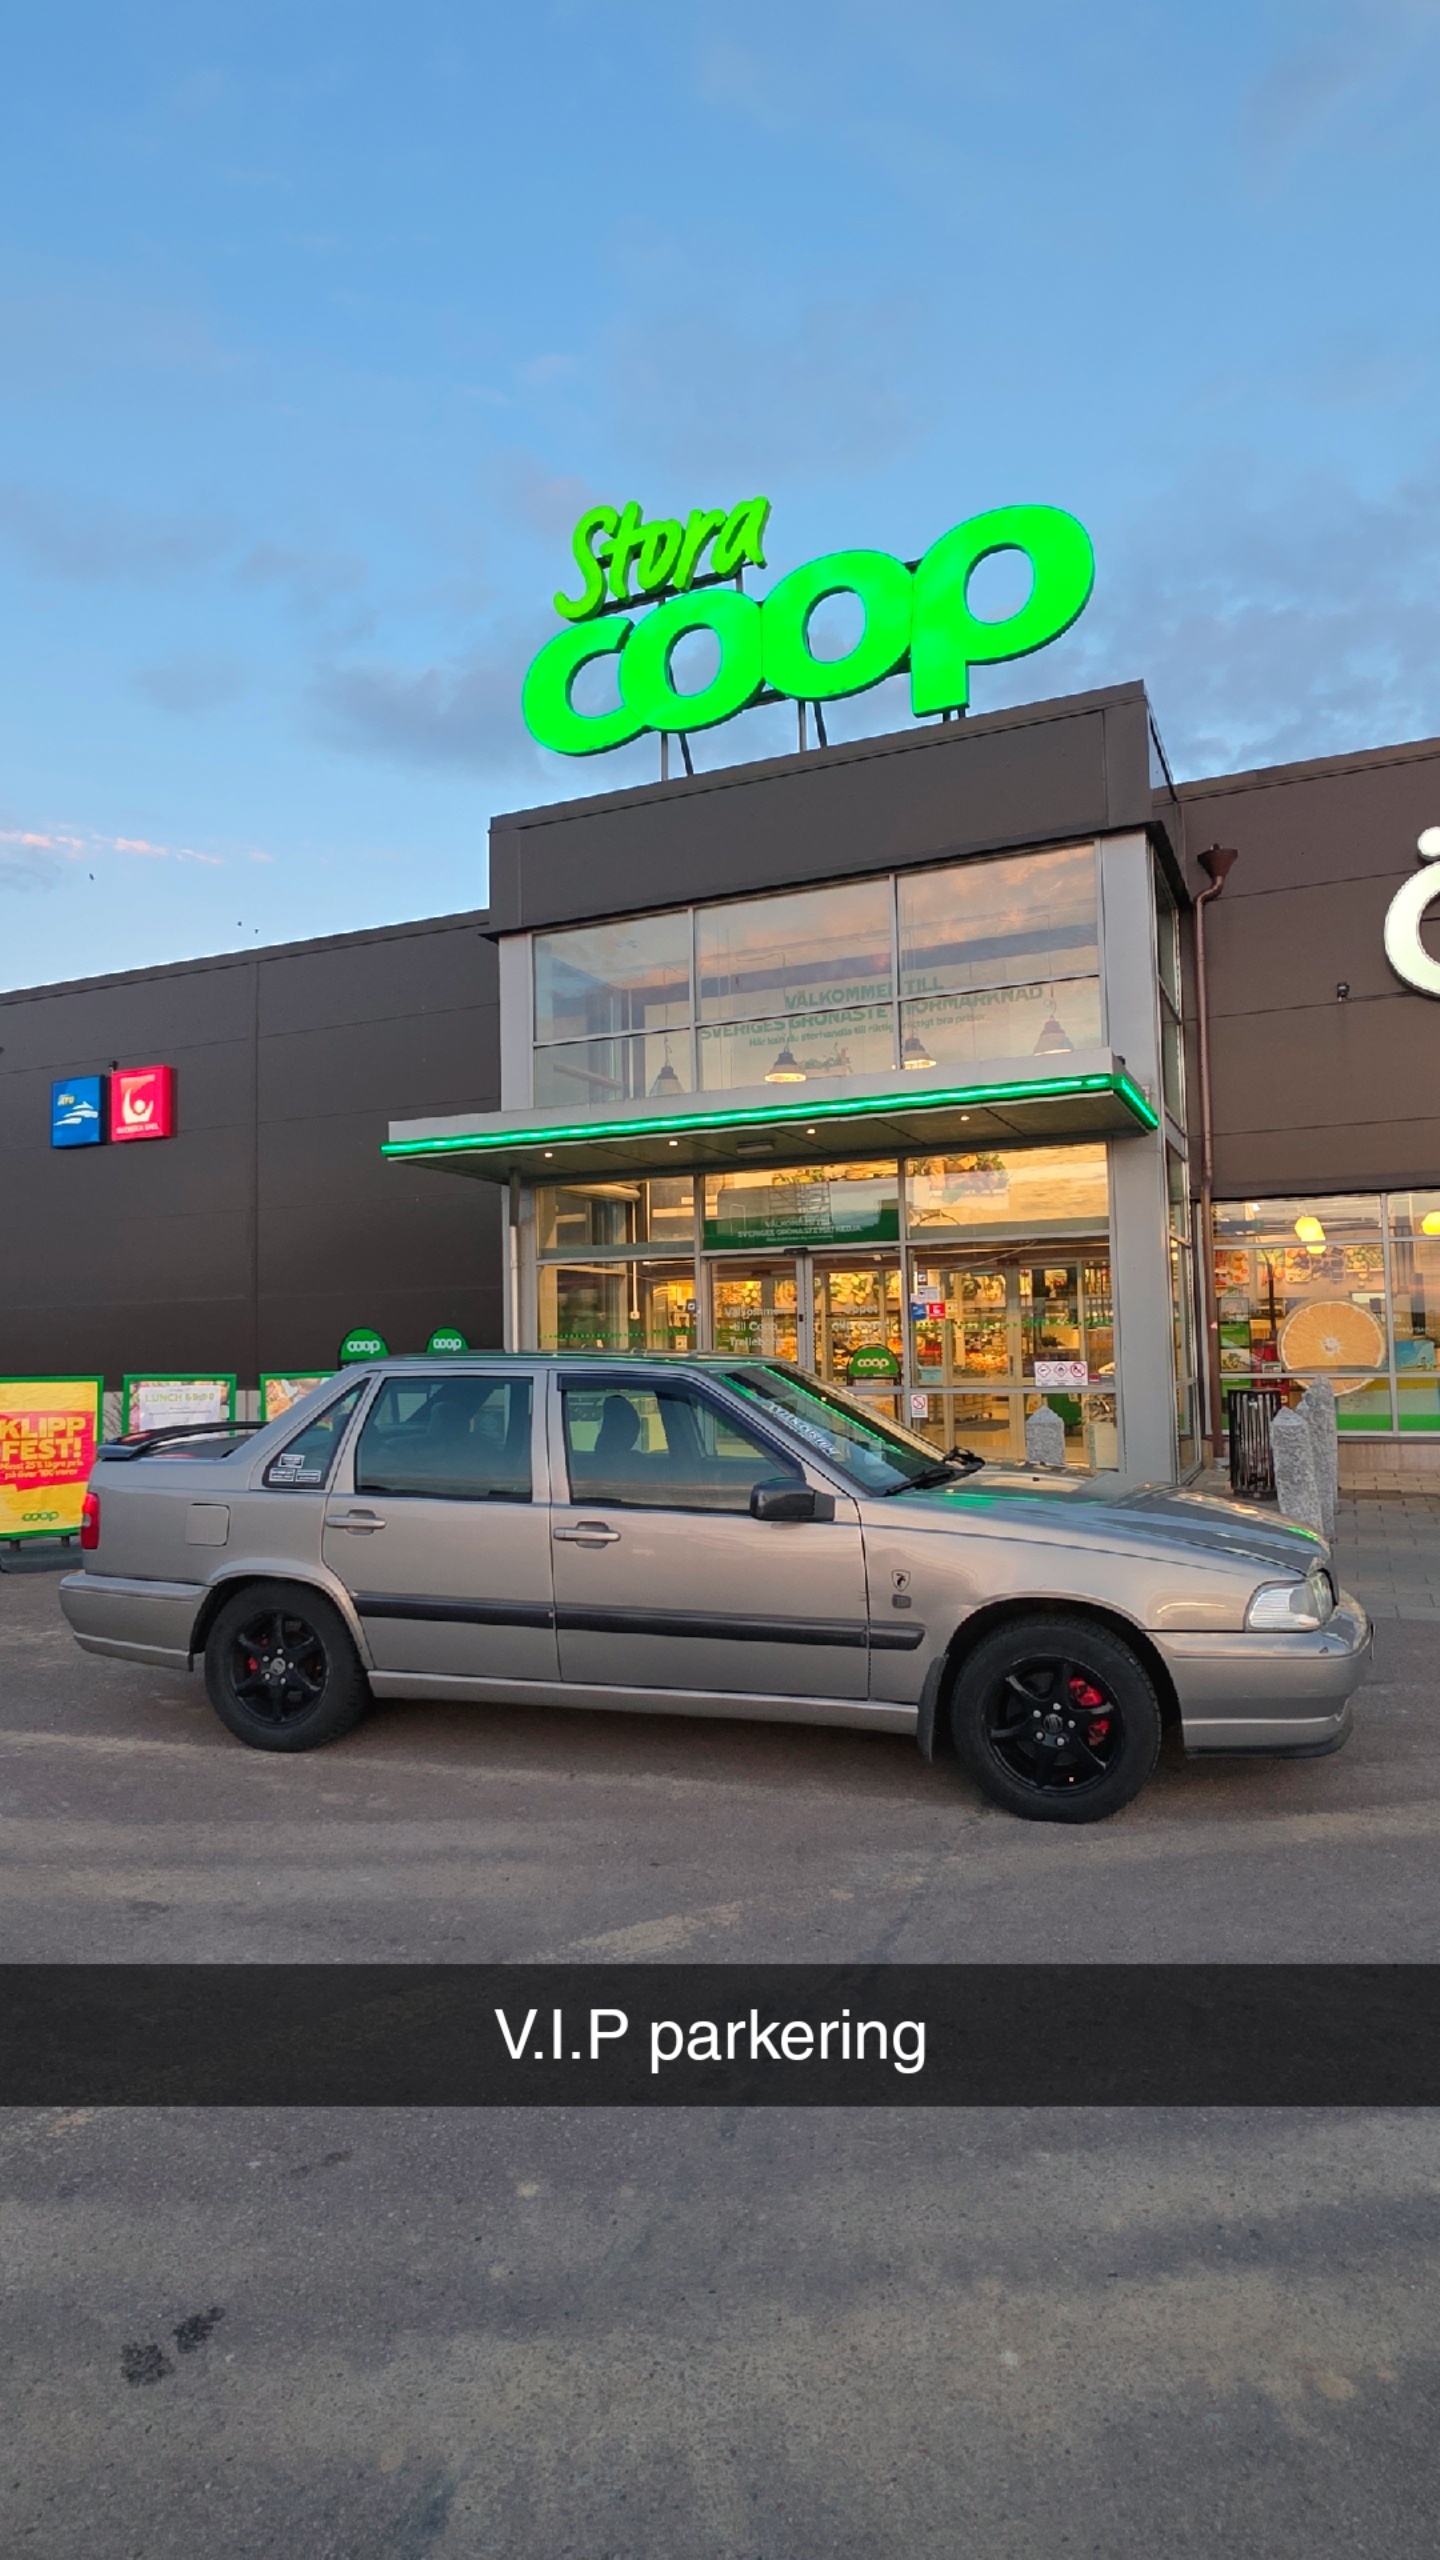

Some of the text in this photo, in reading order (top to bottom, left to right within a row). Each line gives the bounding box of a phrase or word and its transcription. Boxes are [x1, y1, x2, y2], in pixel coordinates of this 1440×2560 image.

[554, 496, 771, 621] Stora
[521, 504, 1095, 756] coop
[904, 976, 944, 995] TILL
[346, 1340, 381, 1354] coop
[432, 1338, 462, 1351] coop
[857, 1358, 890, 1370] coop
[145, 1393, 183, 1402] LUNCH
[0, 1416, 86, 1440] KLIPP
[2, 1436, 82, 1461] FEST!
[21, 1511, 60, 1522] coop
